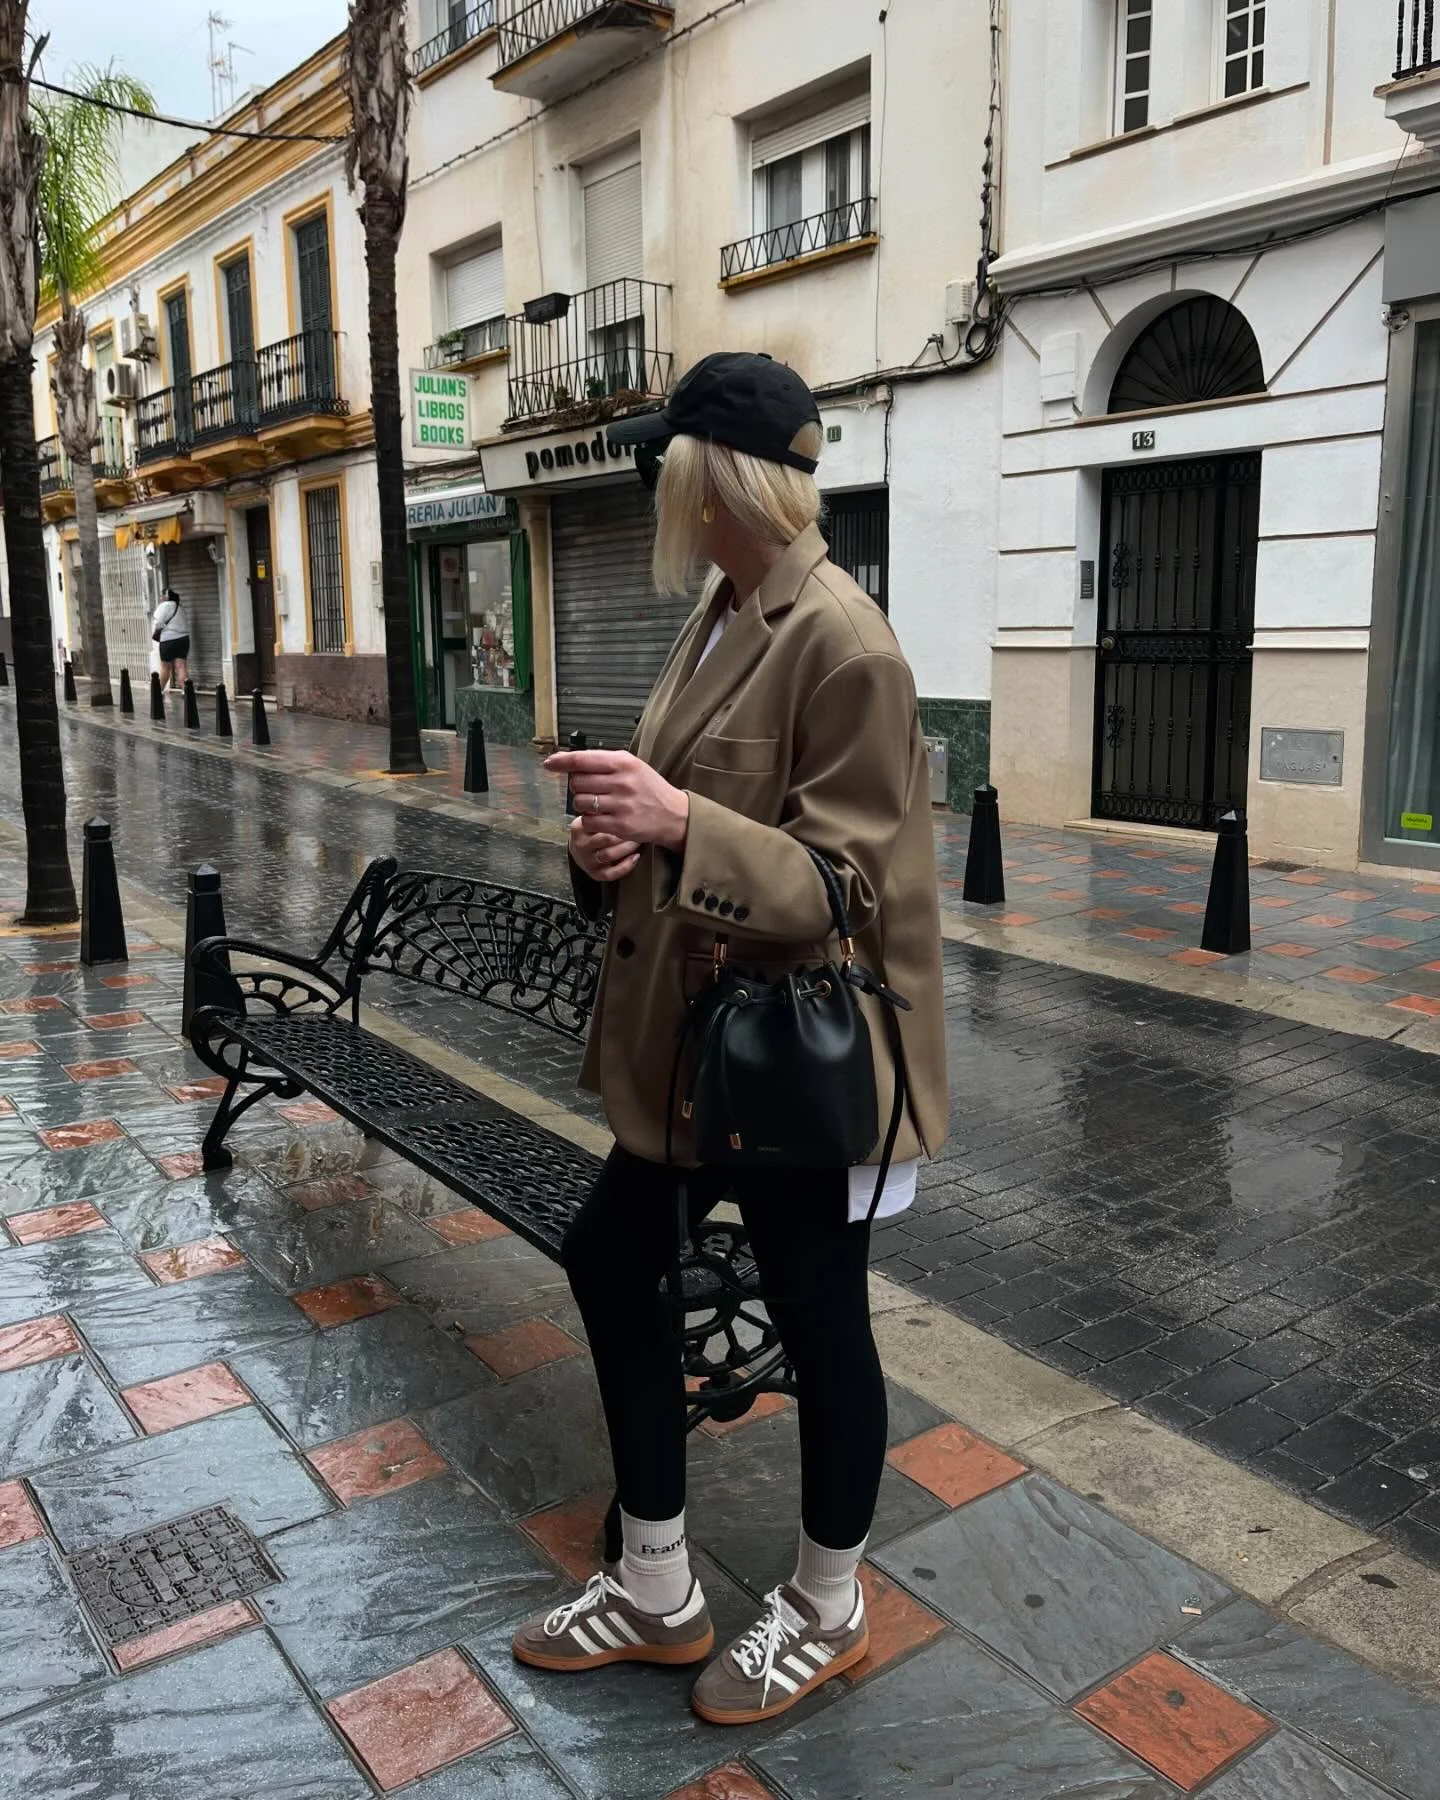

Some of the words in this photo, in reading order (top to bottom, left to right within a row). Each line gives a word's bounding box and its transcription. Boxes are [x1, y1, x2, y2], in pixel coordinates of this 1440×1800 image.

[415, 375, 466, 397] JULIAN'S
[418, 400, 464, 420] LIBROS
[420, 425, 464, 444] BOOKS
[1134, 432, 1153, 447] 13
[448, 495, 497, 518] JULIAN
